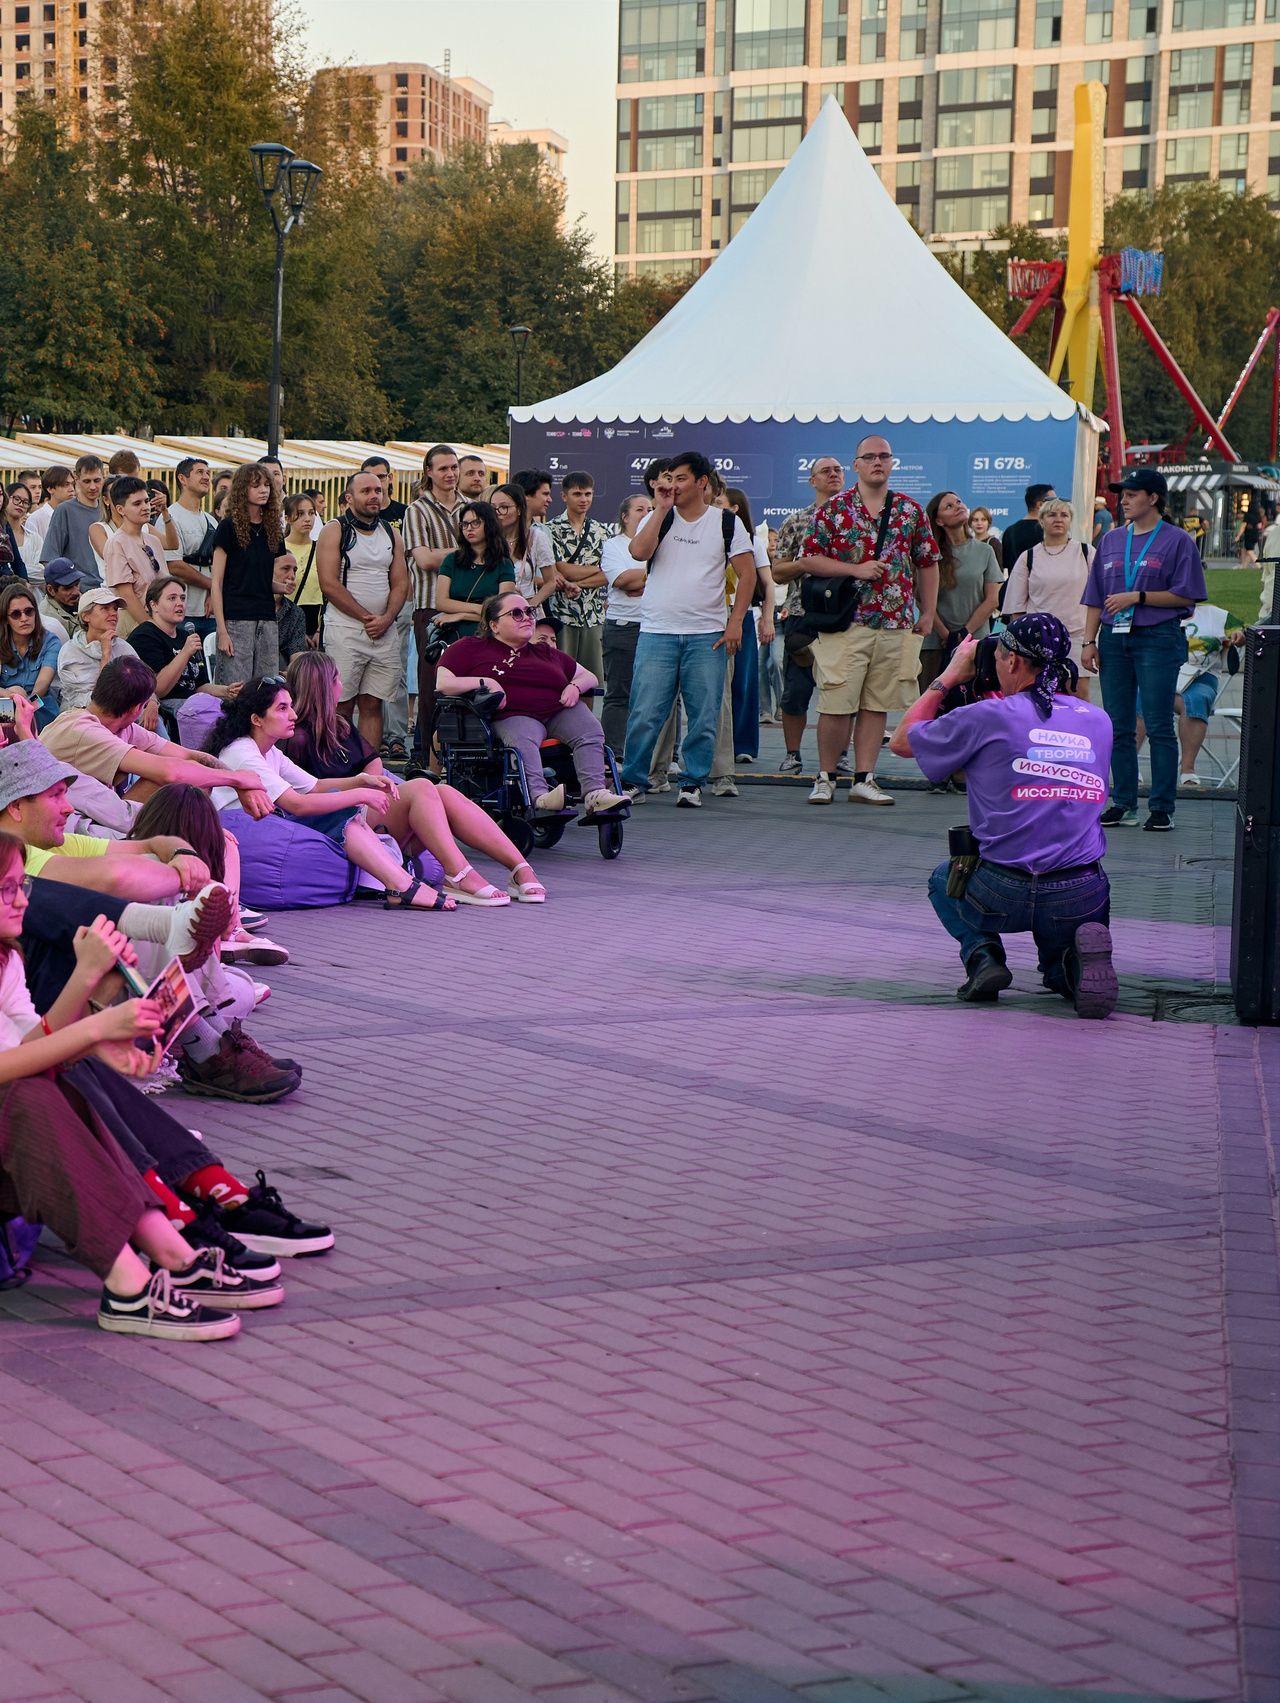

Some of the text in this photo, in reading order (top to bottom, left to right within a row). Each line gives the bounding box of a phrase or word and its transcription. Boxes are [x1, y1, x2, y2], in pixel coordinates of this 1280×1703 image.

[549, 457, 559, 470] 3
[714, 458, 734, 471] 30
[973, 457, 990, 470] 51
[994, 457, 1025, 470] 678
[1157, 464, 1212, 473] ЛАКОМСТВА
[1038, 732, 1086, 748] НАУКА
[1034, 749, 1091, 761] ТВОРИТ
[1019, 761, 1102, 789] ИСКУССТВО
[1017, 788, 1102, 800] ИССЛЕДУЕТ
